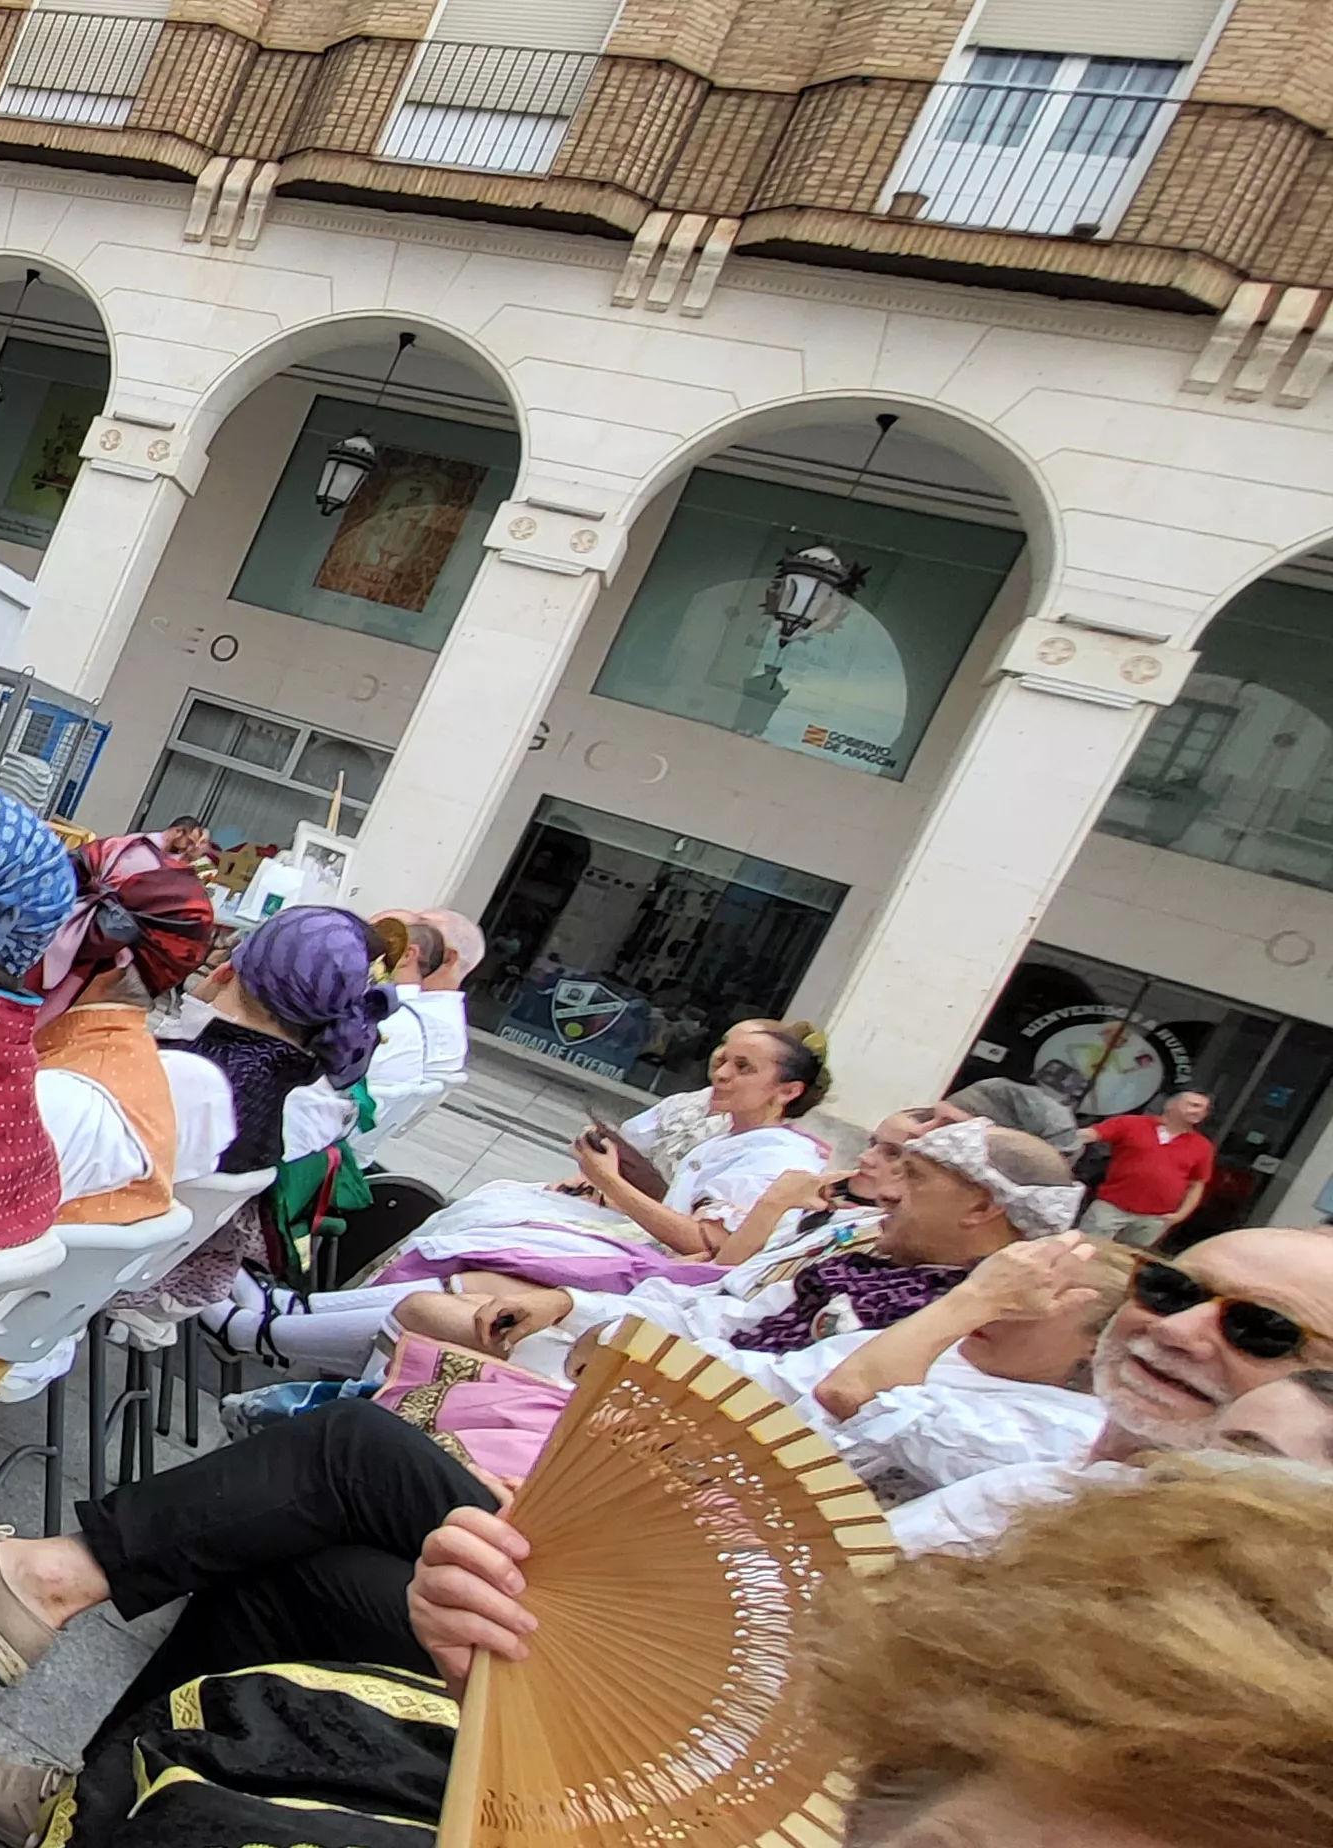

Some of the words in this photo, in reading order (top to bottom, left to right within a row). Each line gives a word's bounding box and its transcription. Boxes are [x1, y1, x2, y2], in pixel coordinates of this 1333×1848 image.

[823, 740, 841, 753] DE
[827, 731, 892, 757] GOBIERNO
[500, 1025, 546, 1055] CIUDAD
[546, 1043, 569, 1061] DE
[566, 1050, 626, 1082] LEYENDA
